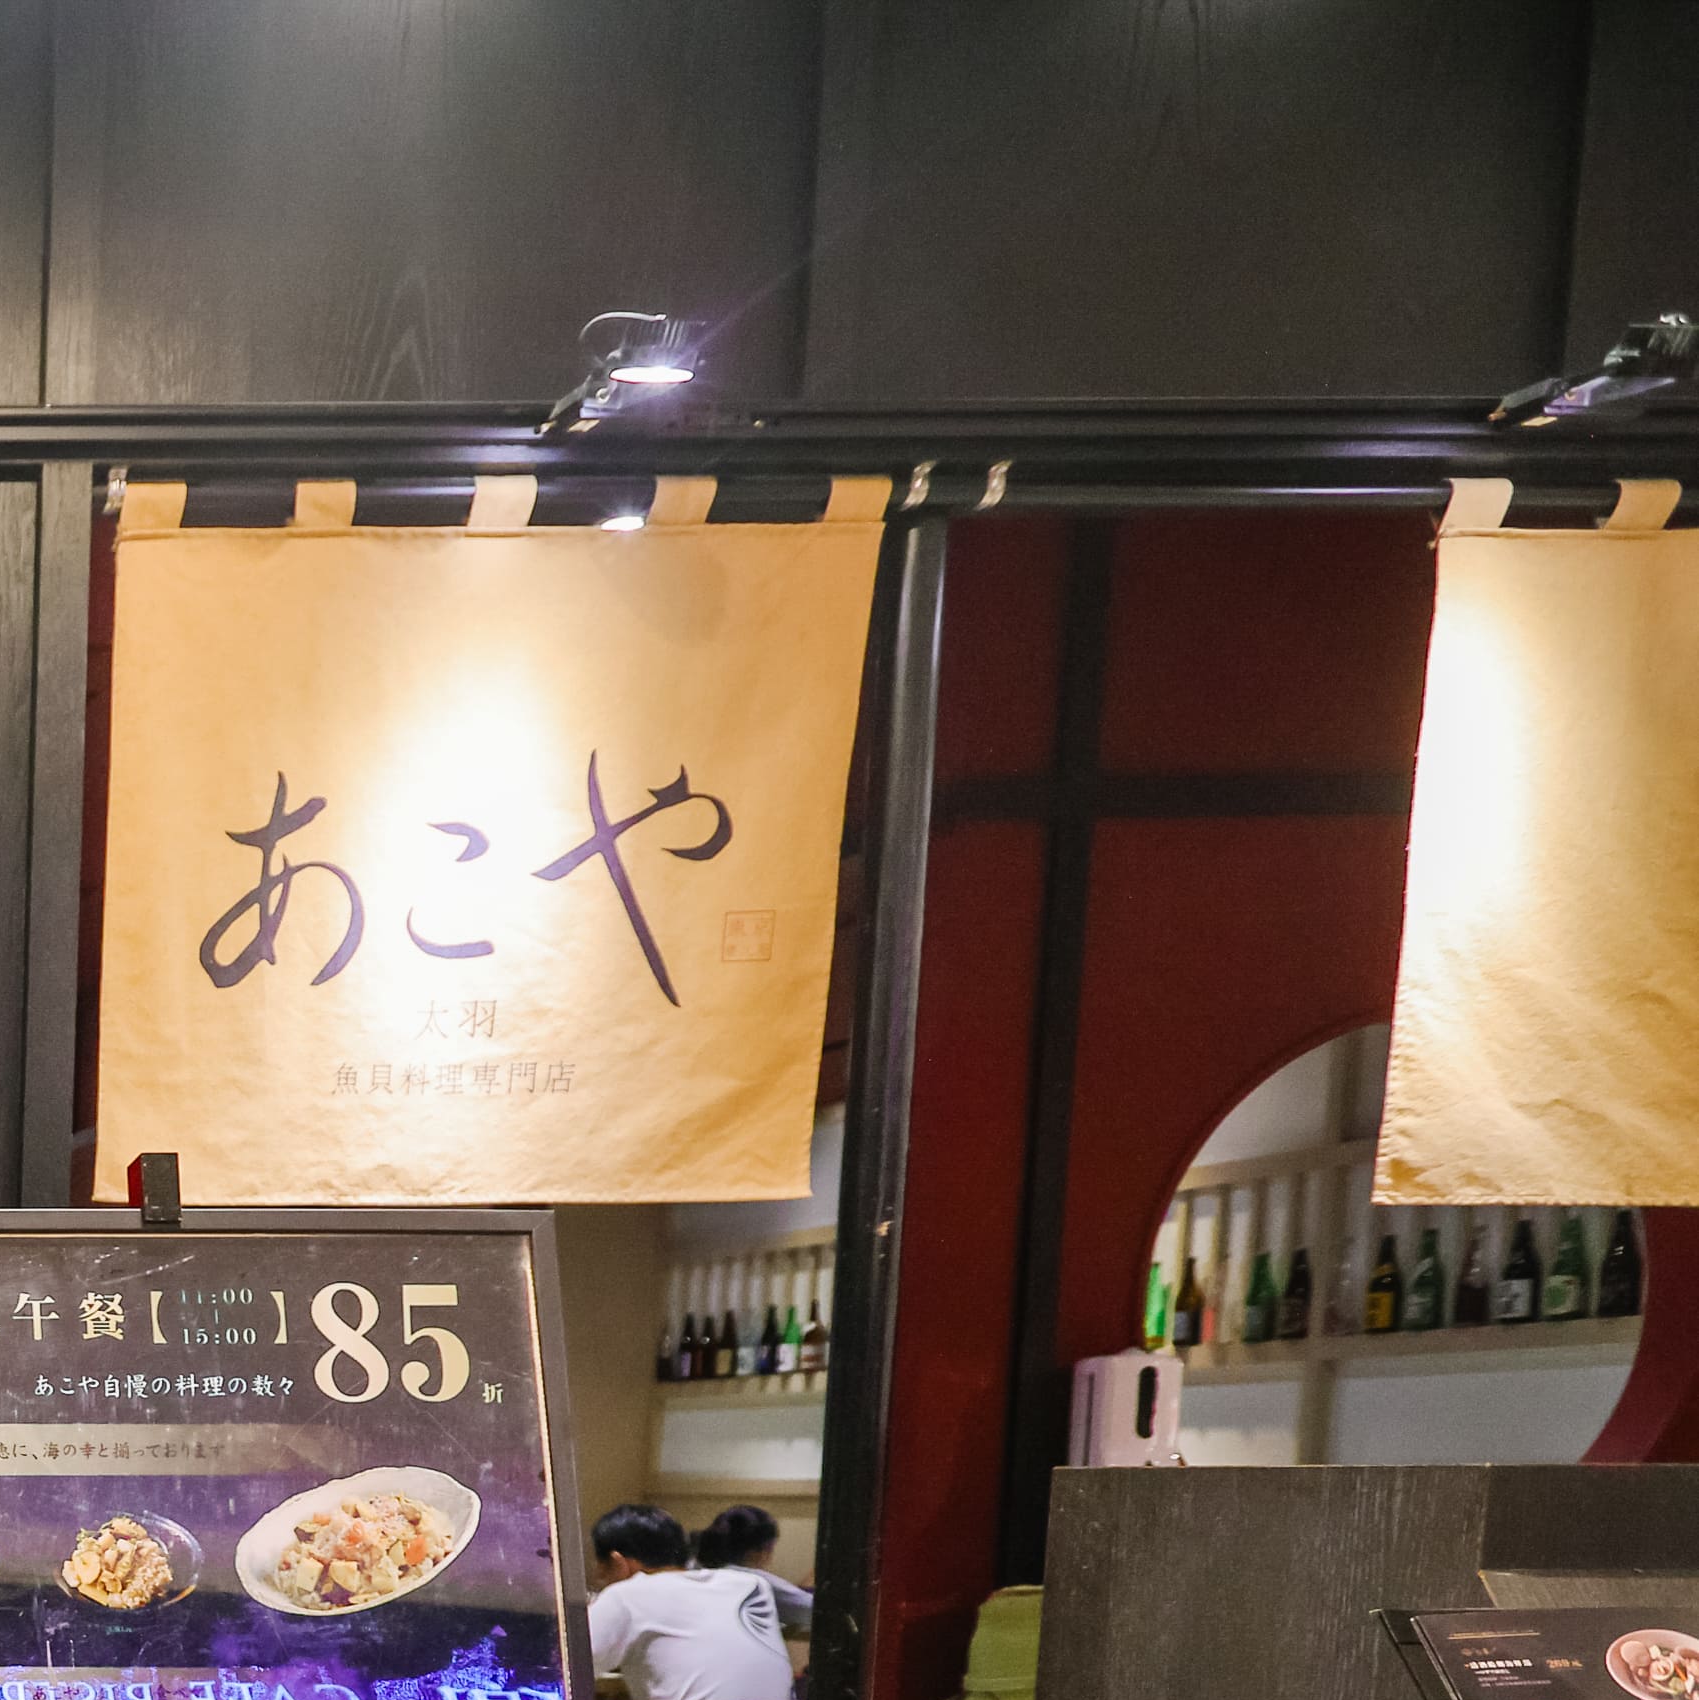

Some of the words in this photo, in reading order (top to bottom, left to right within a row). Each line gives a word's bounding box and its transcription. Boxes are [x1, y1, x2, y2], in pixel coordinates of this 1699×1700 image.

[199, 749, 734, 1008] あこや
[414, 999, 500, 1040] 太羽
[310, 1281, 471, 1404] 85
